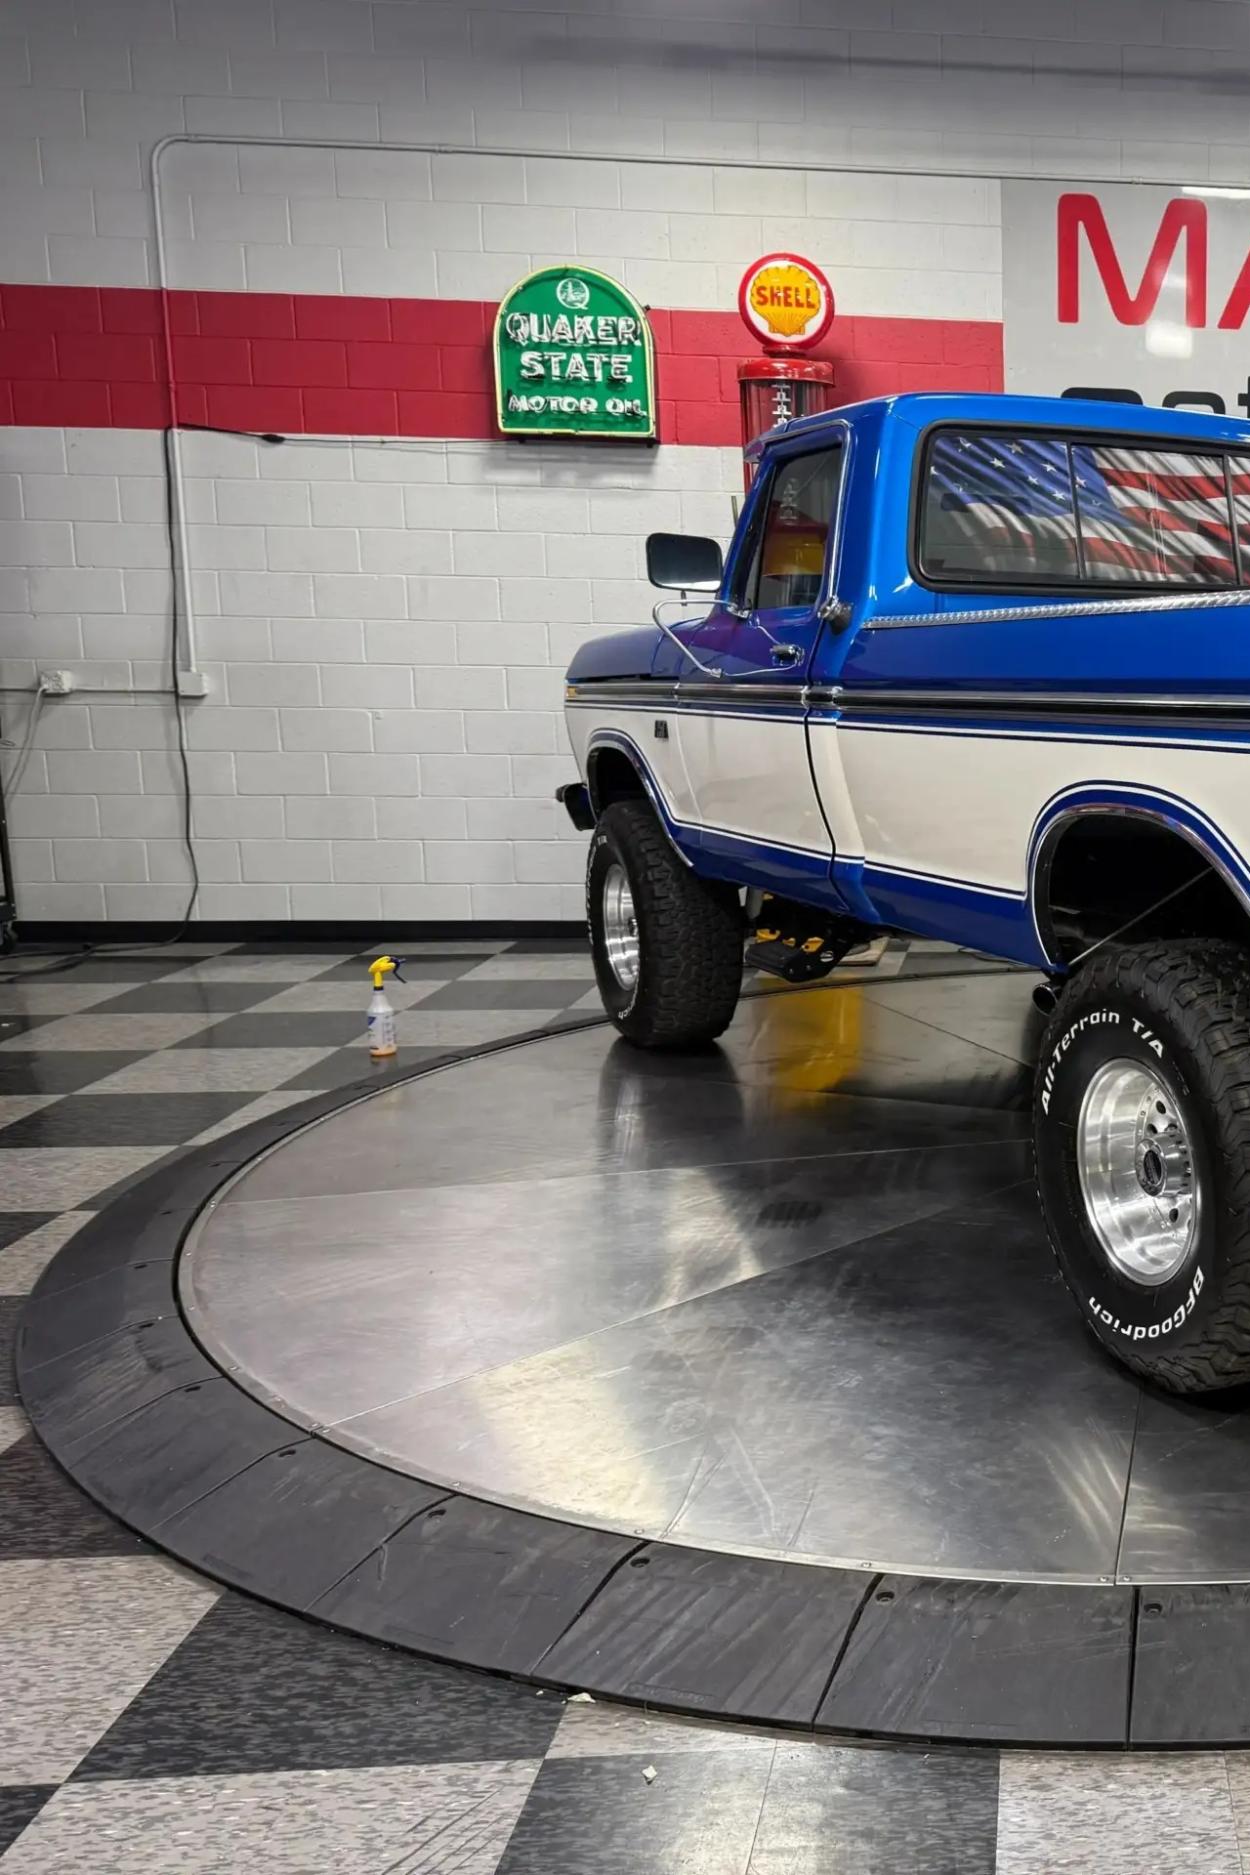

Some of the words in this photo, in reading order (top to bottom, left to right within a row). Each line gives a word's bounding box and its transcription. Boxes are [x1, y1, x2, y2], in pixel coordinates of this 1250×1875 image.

[756, 286, 815, 309] SHELL
[505, 312, 642, 346] QUAKER
[520, 351, 634, 383] STATE
[508, 394, 599, 414] MOTOR
[605, 397, 647, 417] OIL
[1041, 1008, 1120, 1115] All-Terrain
[1132, 1017, 1163, 1058] T/A
[1088, 1265, 1204, 1340] BFGoodrich
